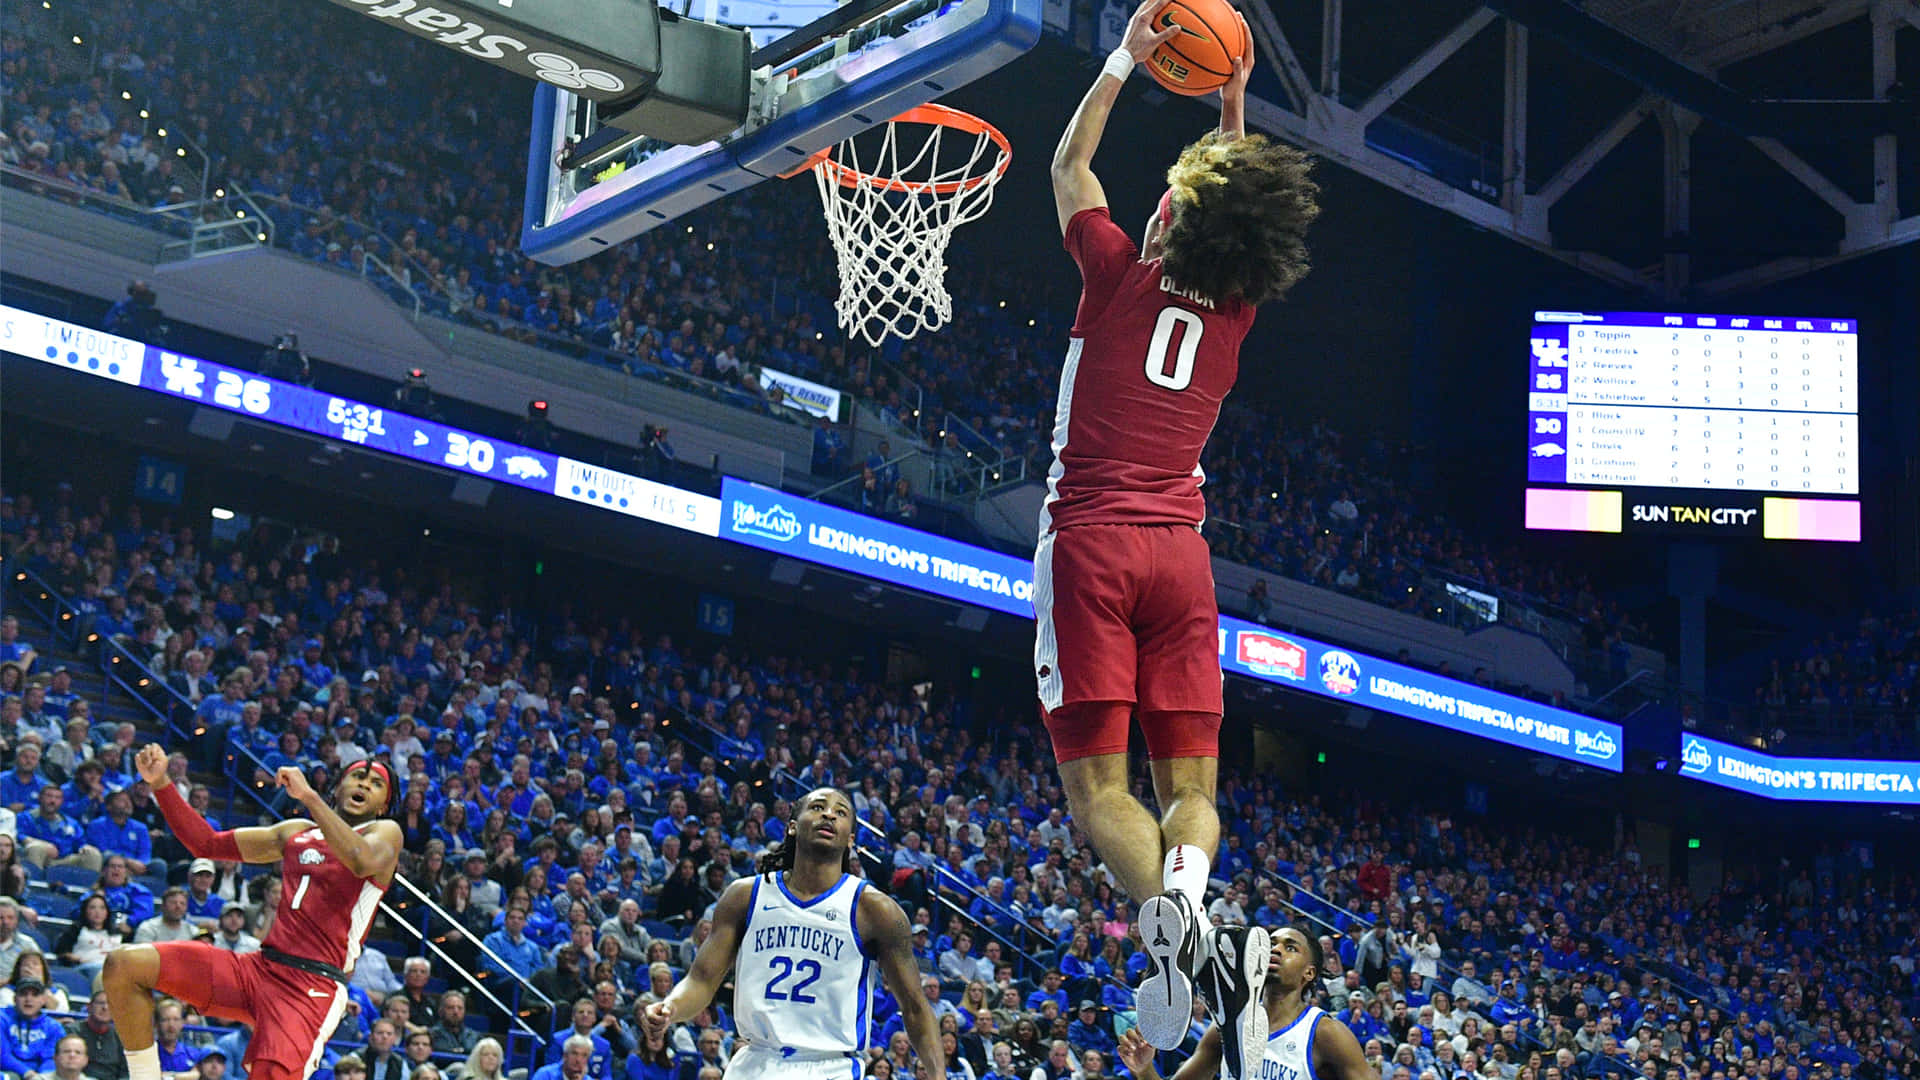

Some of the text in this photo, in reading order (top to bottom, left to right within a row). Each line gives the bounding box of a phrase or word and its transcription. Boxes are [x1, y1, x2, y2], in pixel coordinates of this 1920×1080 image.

[1151, 47, 1189, 80] LITE
[44, 321, 129, 360] TIMEOUTS
[1144, 305, 1204, 392] 0
[1593, 329, 1632, 342] Toppin
[1592, 360, 1633, 370] Reeves
[214, 370, 271, 415] 26
[327, 397, 386, 436] 5:31
[1535, 418, 1561, 433] 30
[445, 432, 495, 473] 30
[143, 465, 177, 496] 14
[569, 464, 635, 497] TIMEOUTS
[686, 503, 697, 522] 5
[1632, 505, 1753, 525] SUN TAN CITY
[808, 523, 929, 574] LEXINGTON'S
[931, 556, 1012, 598] TRIFECTA
[703, 602, 729, 627] 15
[1370, 676, 1457, 715] LEXINGTON'S
[1457, 699, 1515, 730] TRIFECTA
[1515, 716, 1534, 735] OF
[1535, 721, 1570, 745] TASTE
[1717, 755, 1816, 789] LEXINGTON'S
[1818, 772, 1914, 792] TRIFECTA
[291, 874, 311, 910] 1
[754, 925, 845, 961] KENTUCKY
[765, 956, 822, 1004] 22
